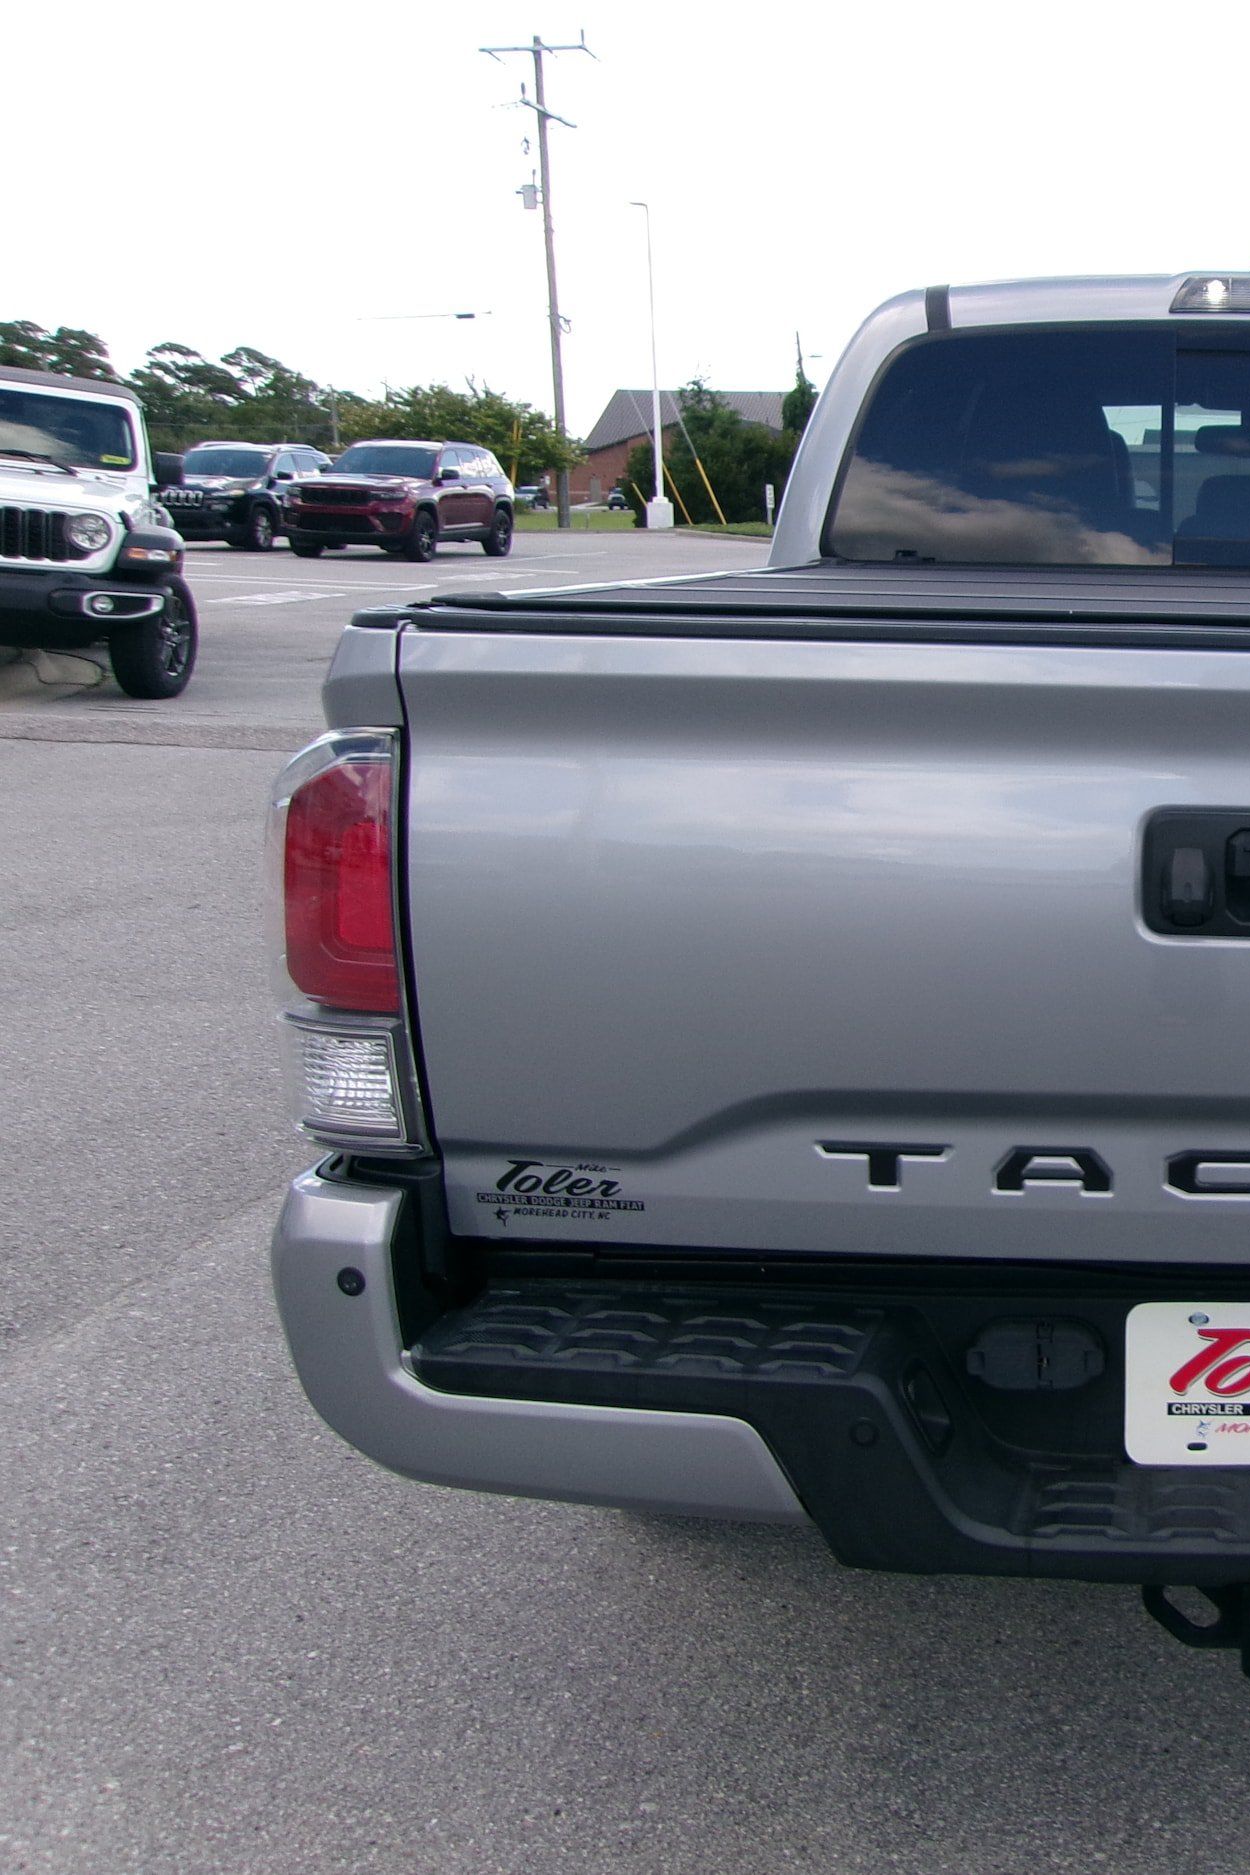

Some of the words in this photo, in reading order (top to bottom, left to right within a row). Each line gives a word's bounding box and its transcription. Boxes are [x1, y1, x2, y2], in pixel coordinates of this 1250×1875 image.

[576, 1163, 608, 1173] Mike
[496, 1159, 622, 1197] Toler
[478, 1192, 528, 1205] CHRYSLER
[531, 1195, 566, 1208] DODGE
[569, 1198, 592, 1209] JEEP
[595, 1200, 618, 1211] RAM
[620, 1201, 644, 1212] FIAT
[513, 1206, 568, 1218] MOREHEAD
[598, 1210, 611, 1221] NC
[1171, 1403, 1244, 1416] CHRYSLER
